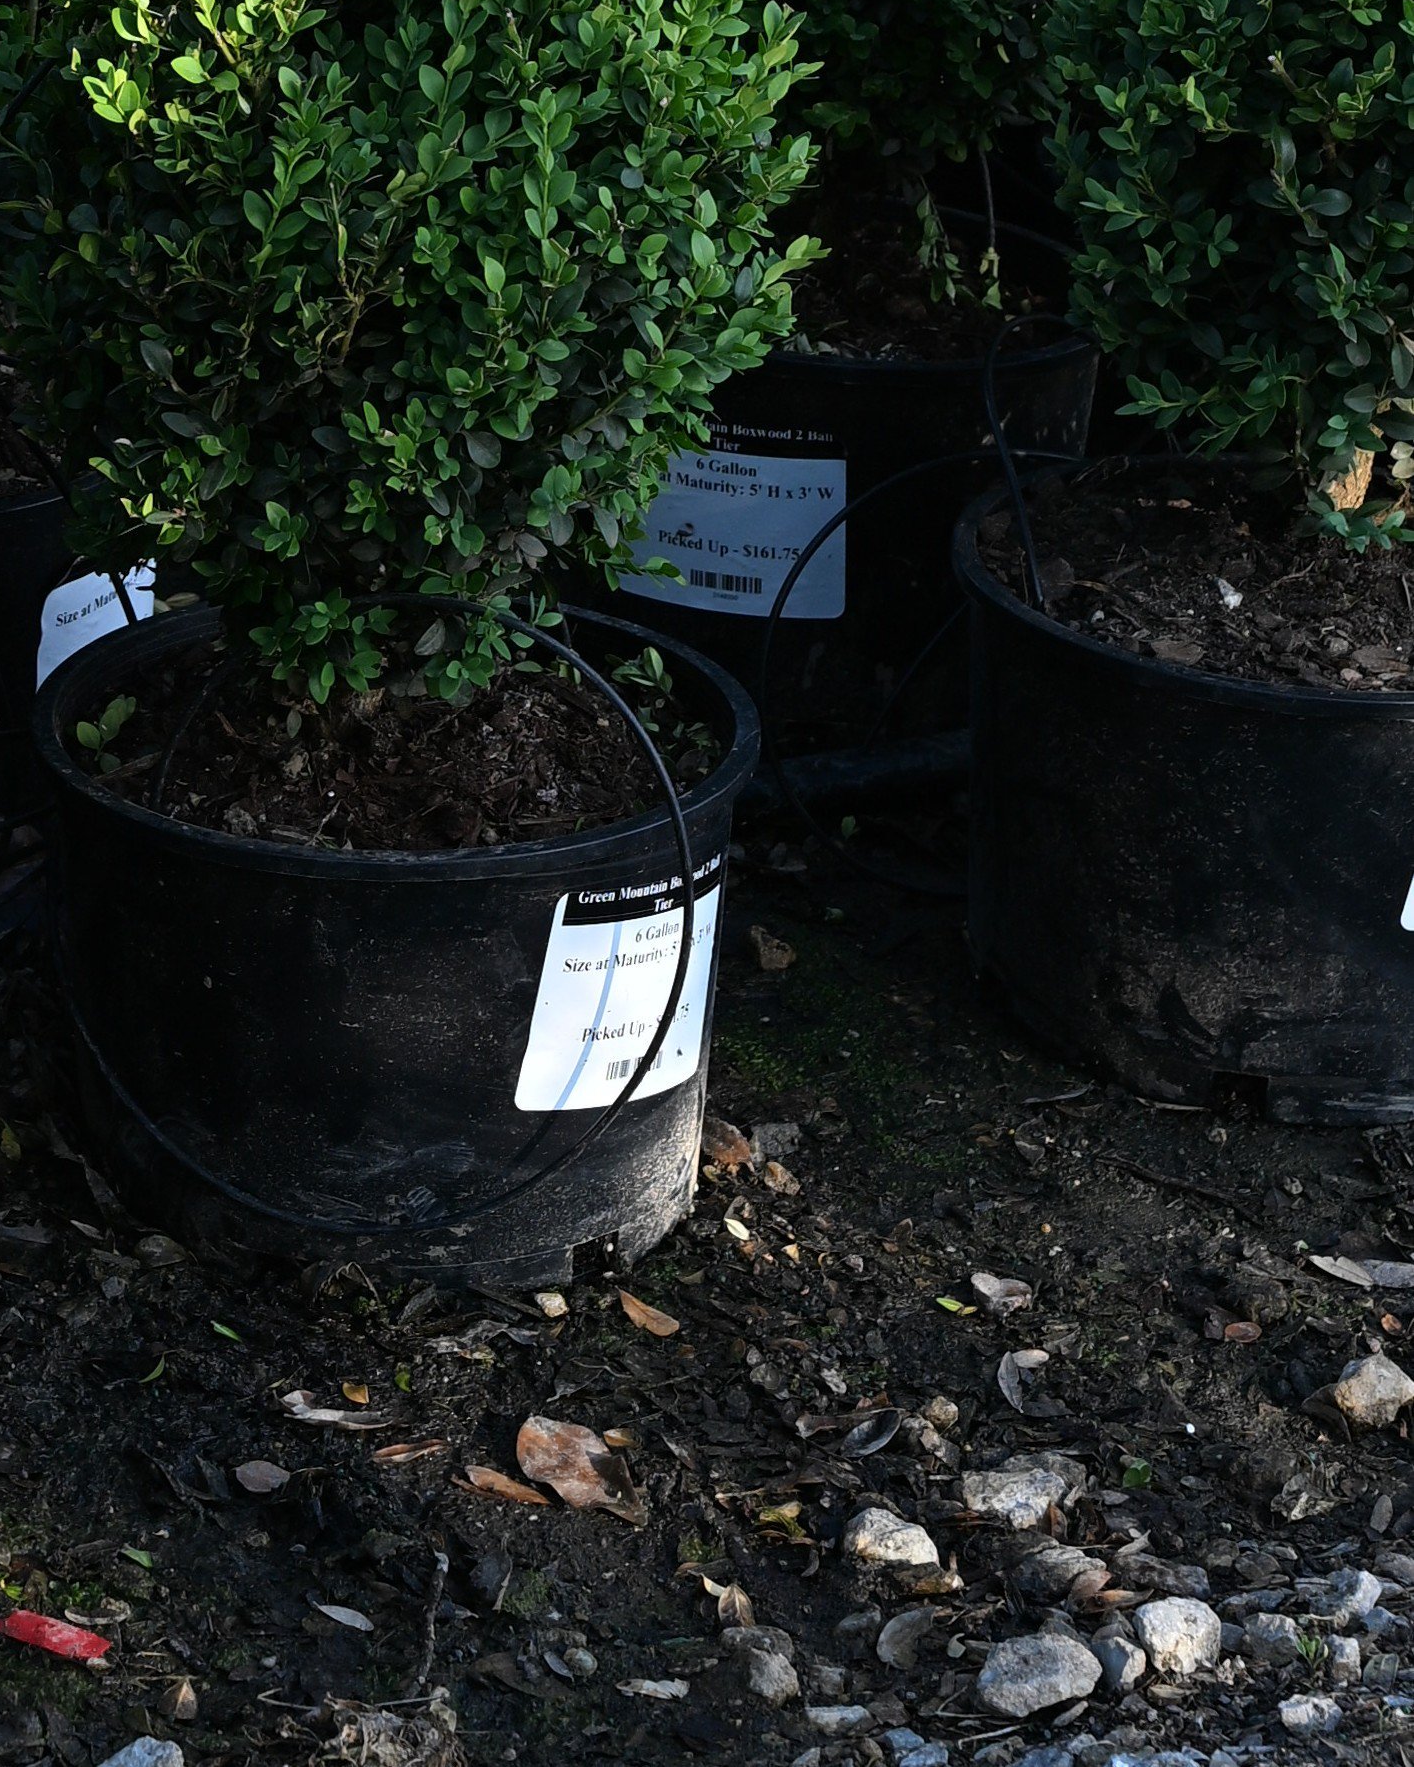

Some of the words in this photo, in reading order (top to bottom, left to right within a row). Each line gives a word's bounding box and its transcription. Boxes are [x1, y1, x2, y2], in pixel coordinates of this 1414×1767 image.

[713, 436, 741, 451] Tier
[732, 424, 792, 440] Boxwood
[796, 429, 803, 440] 2
[808, 430, 833, 442] Ball
[696, 457, 705, 470] 6
[708, 458, 758, 478] Gallon
[676, 473, 745, 498] Maturity:
[749, 484, 763, 497] 5'
[767, 485, 780, 499] H
[785, 490, 794, 499] x
[798, 486, 812, 500] 3'
[817, 486, 834, 500] W
[658, 529, 703, 551] Picked
[708, 540, 729, 558] Up
[742, 544, 800, 561] $161.75
[55, 611, 79, 627] Size
[81, 602, 91, 616] at
[579, 890, 615, 904] Green
[619, 879, 668, 900] Mountain
[654, 897, 674, 912] Tier
[635, 928, 642, 943] 6
[646, 922, 679, 941] Gallon
[562, 958, 592, 973] Size
[595, 957, 609, 970] at
[612, 947, 667, 969] Maturity:
[582, 1023, 625, 1042] Picked
[629, 1020, 645, 1037] Up
